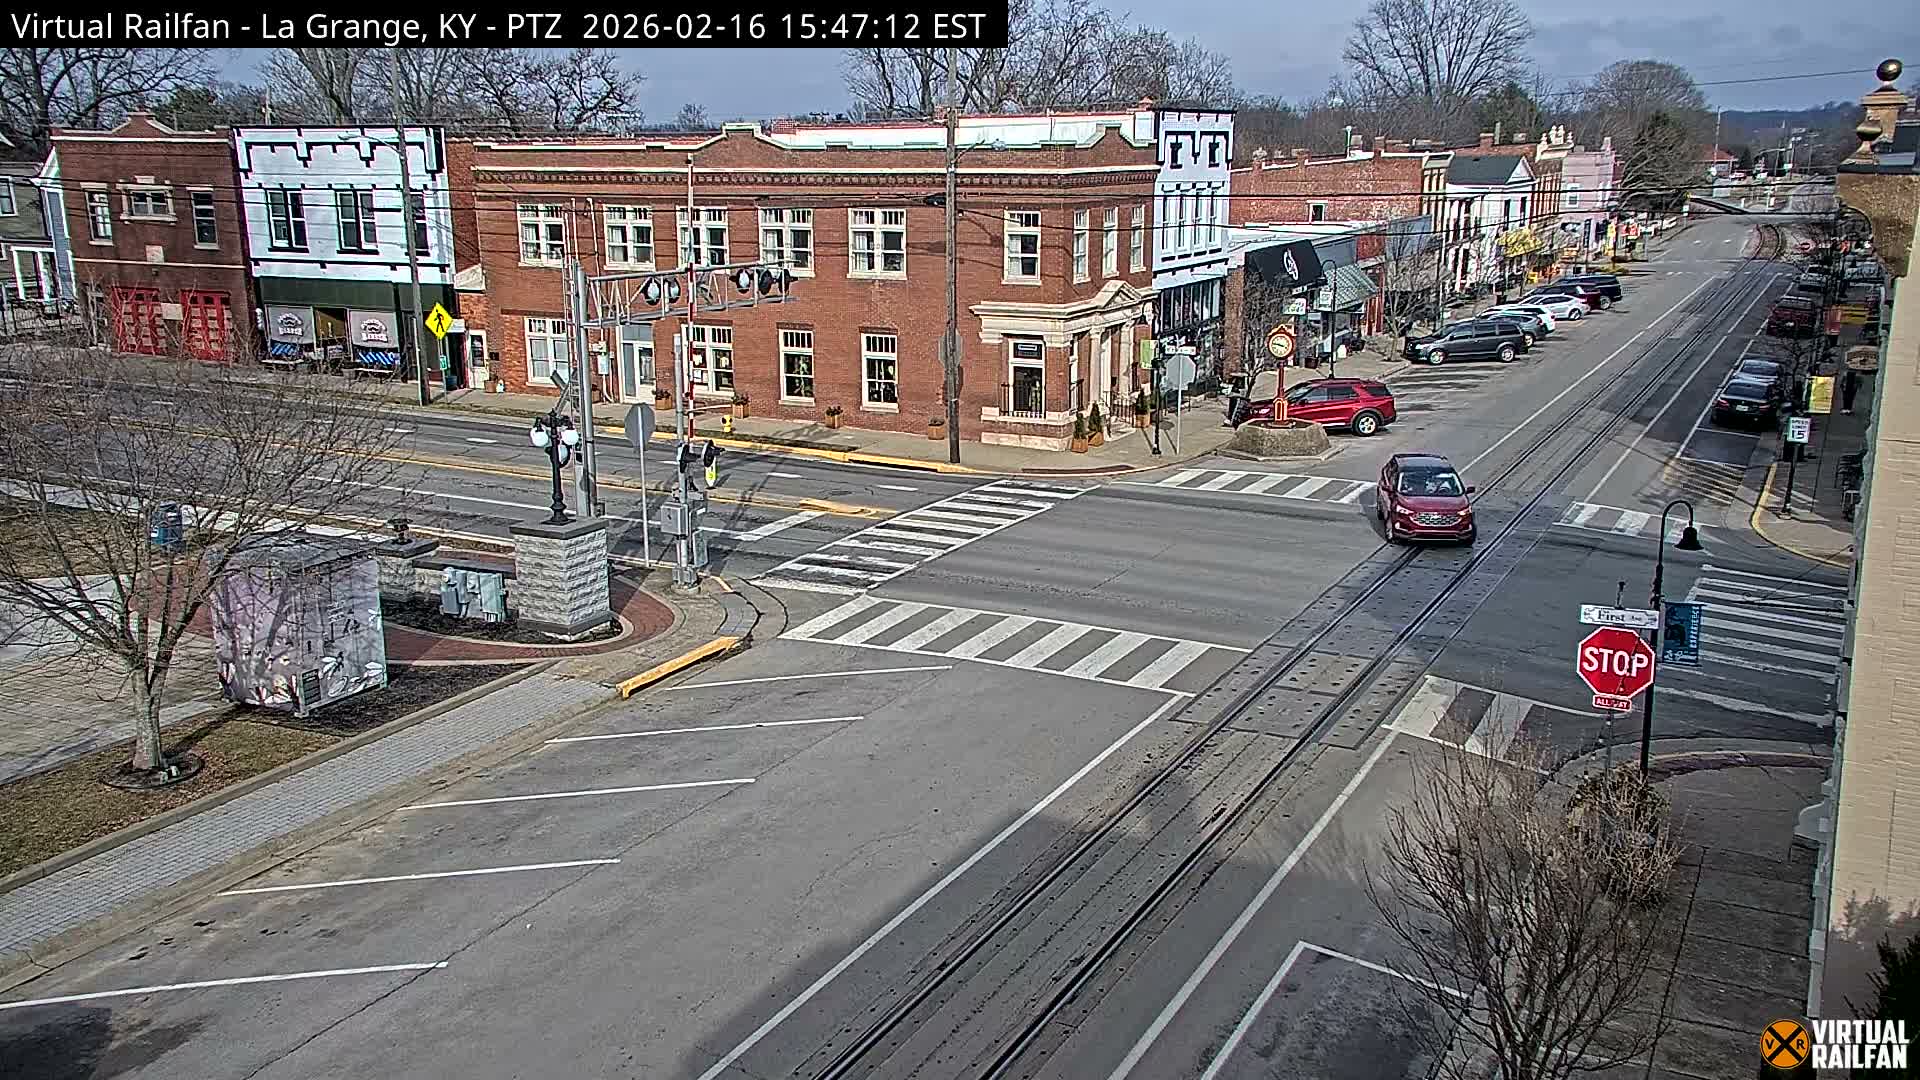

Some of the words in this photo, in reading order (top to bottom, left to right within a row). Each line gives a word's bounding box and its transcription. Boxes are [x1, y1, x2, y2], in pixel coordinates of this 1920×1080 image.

[1790, 430, 1805, 440] 15
[1597, 609, 1625, 622] First
[1583, 646, 1649, 678] STOP
[1596, 697, 1610, 706] ALL
